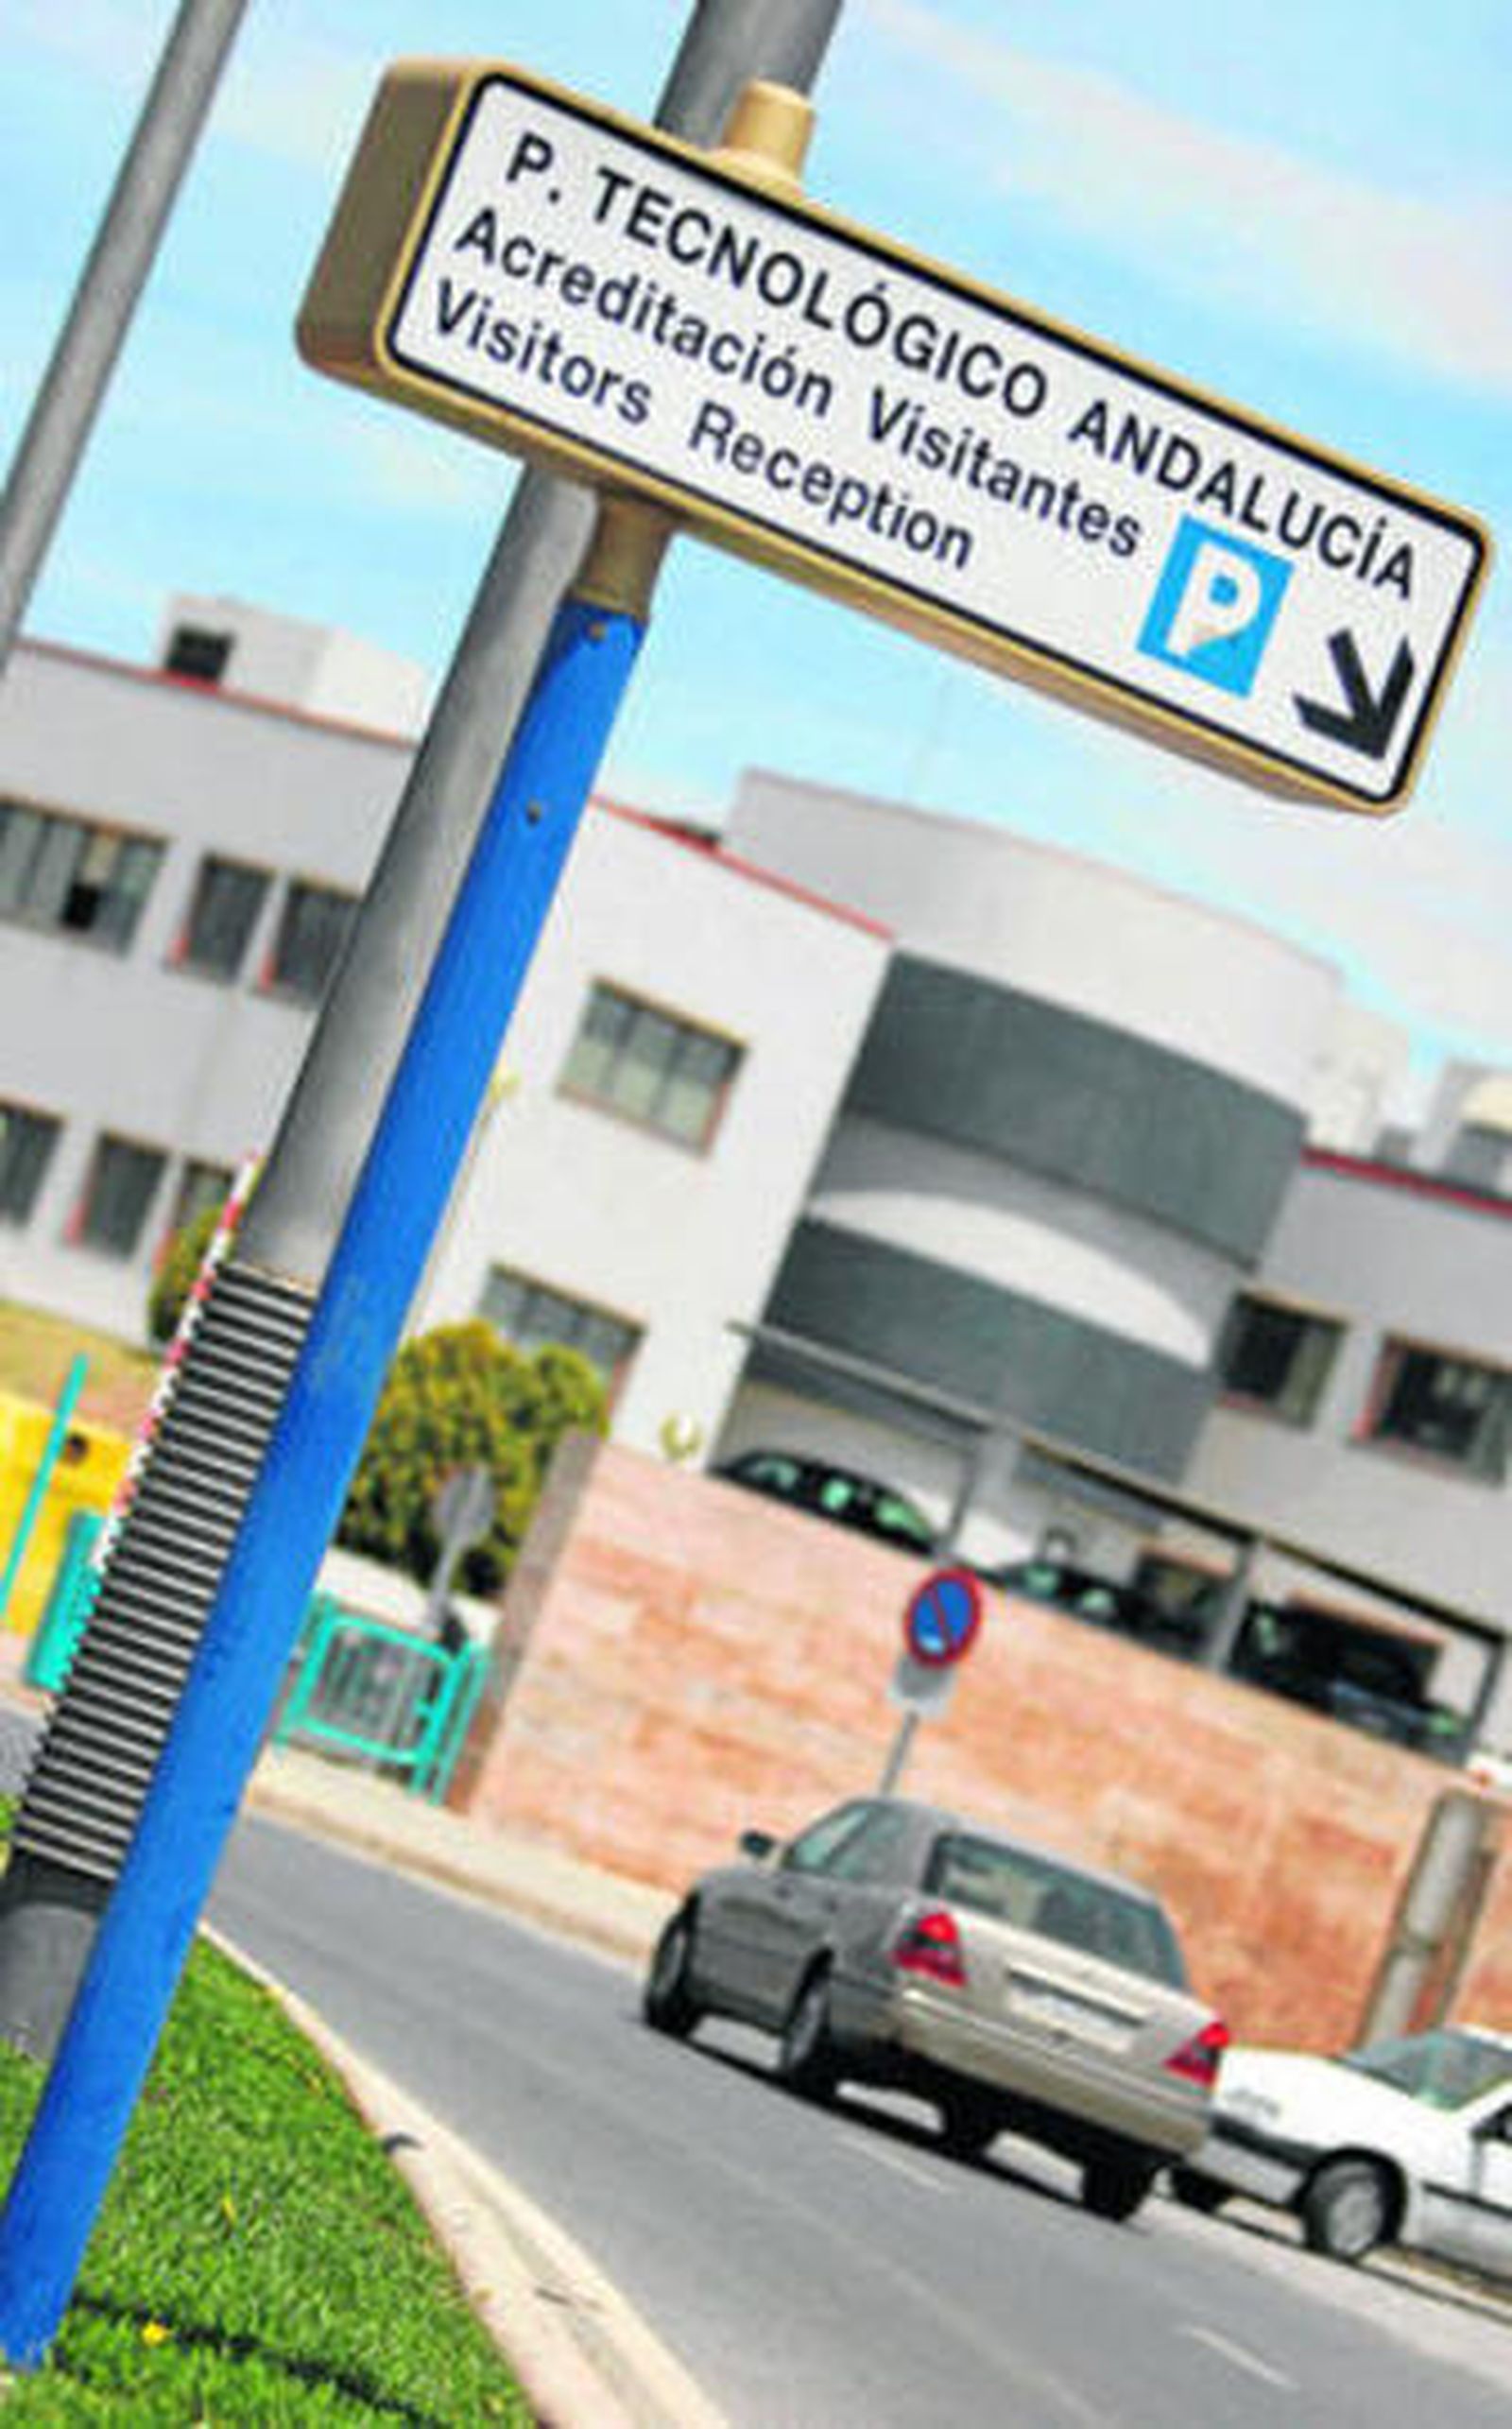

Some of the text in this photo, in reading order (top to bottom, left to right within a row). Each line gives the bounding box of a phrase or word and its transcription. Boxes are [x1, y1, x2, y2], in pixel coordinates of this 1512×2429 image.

[435, 279, 973, 568] Visitors Reception
[455, 208, 1142, 558] Acreditación Visitantes
[507, 133, 1414, 598] P. TECNOLÓGICO ANDALUCÍA
